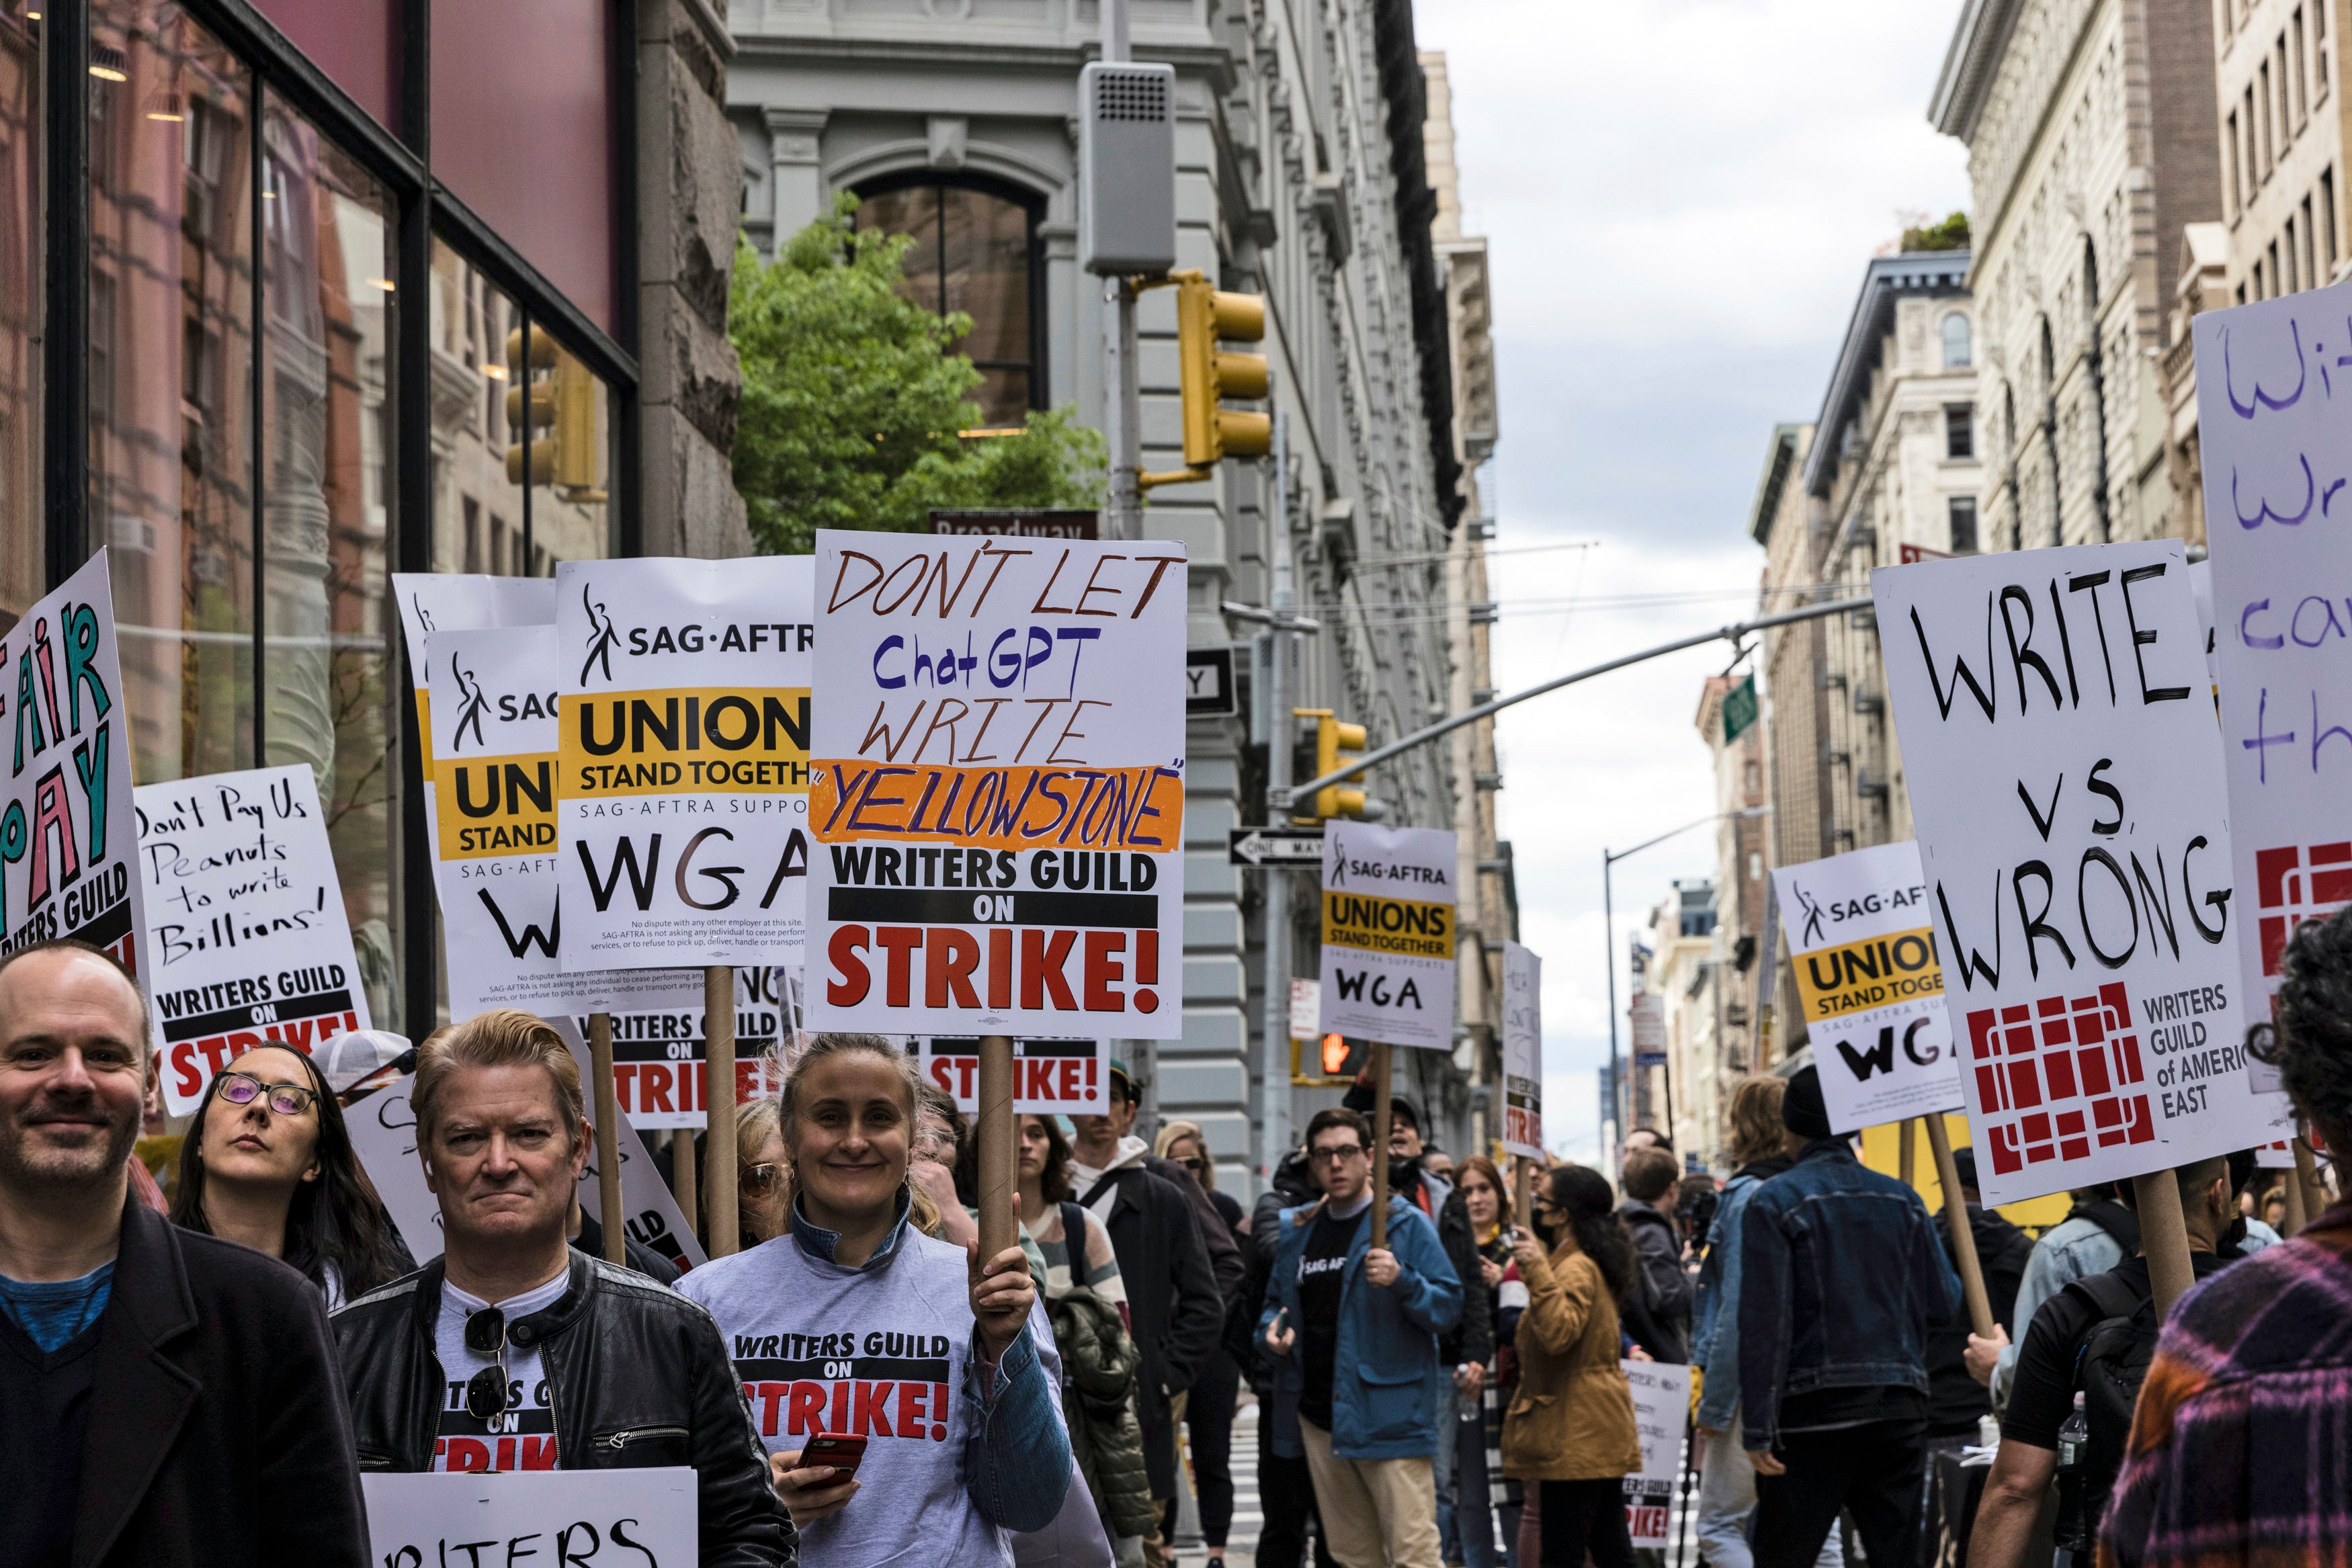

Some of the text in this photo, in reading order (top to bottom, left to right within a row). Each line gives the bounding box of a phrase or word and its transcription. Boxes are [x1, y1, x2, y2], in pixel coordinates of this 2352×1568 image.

[827, 539, 1188, 619] DON'T LET
[2241, 595, 2352, 650] ca
[1910, 562, 2192, 724] WRITE
[872, 625, 1101, 701] ChatGPT
[857, 697, 1113, 766] WRITE
[455, 760, 558, 819] UN
[580, 760, 810, 791] STAND TOGETH
[216, 785, 264, 829] Pay
[270, 777, 306, 819] Us
[580, 799, 714, 819] SAG-AFTRA
[460, 822, 556, 851] STAND
[142, 833, 287, 885] Peanuts
[576, 827, 807, 913] WGA
[830, 846, 1159, 892] WRITERS GUILD
[64, 861, 128, 930] GUILD
[166, 866, 294, 913] to write
[973, 894, 1015, 922] ON
[632, 920, 642, 928] No
[644, 920, 672, 929] dispute
[674, 918, 689, 926] with
[691, 919, 705, 927] any
[707, 918, 726, 926] other
[728, 918, 761, 928] employer
[788, 918, 803, 926] site.
[1331, 895, 1446, 937] UNIONS
[1935, 835, 2232, 992] WRONG
[591, 941, 622, 951] services,
[642, 939, 665, 947] refuse
[677, 939, 692, 947] pick
[707, 937, 733, 946] deliver,
[735, 938, 759, 946] handle
[770, 939, 804, 947] transport
[602, 930, 645, 940] SAG-AFTRA
[669, 928, 693, 938] asking
[694, 929, 707, 937] any
[709, 928, 744, 936] individual
[1330, 928, 1445, 955] STAND TOGETHER
[489, 983, 530, 993] SAG-AFTRA
[539, 982, 550, 990] not
[552, 979, 574, 989] asking
[575, 979, 587, 988] any
[589, 976, 622, 986] individual
[652, 973, 690, 984] performing
[529, 972, 555, 983] dispute
[827, 924, 1160, 1014] STRIKE!
[155, 964, 346, 1019] WRITERS GUILD
[479, 995, 509, 1003] services,
[528, 991, 550, 1000] refuse
[560, 989, 575, 998] pick
[587, 987, 612, 995] deliver,
[613, 985, 635, 994] handle
[645, 983, 677, 992] transport
[679, 982, 691, 990] any
[1335, 967, 1423, 1010] WGA
[1817, 986, 1886, 1015] STAND
[2142, 984, 2228, 1025] WRITERS
[251, 1003, 278, 1026] ON
[667, 1042, 693, 1059] ON
[1835, 1016, 1957, 1083] WG
[2150, 1020, 2208, 1056] GUILD
[931, 1056, 1098, 1101] STIKE!
[2157, 1059, 2176, 1088] of
[2161, 1084, 2208, 1120] EAST
[734, 1332, 951, 1360] WRITERS GUILD
[823, 1361, 853, 1379] ON
[487, 1413, 520, 1434] ON
